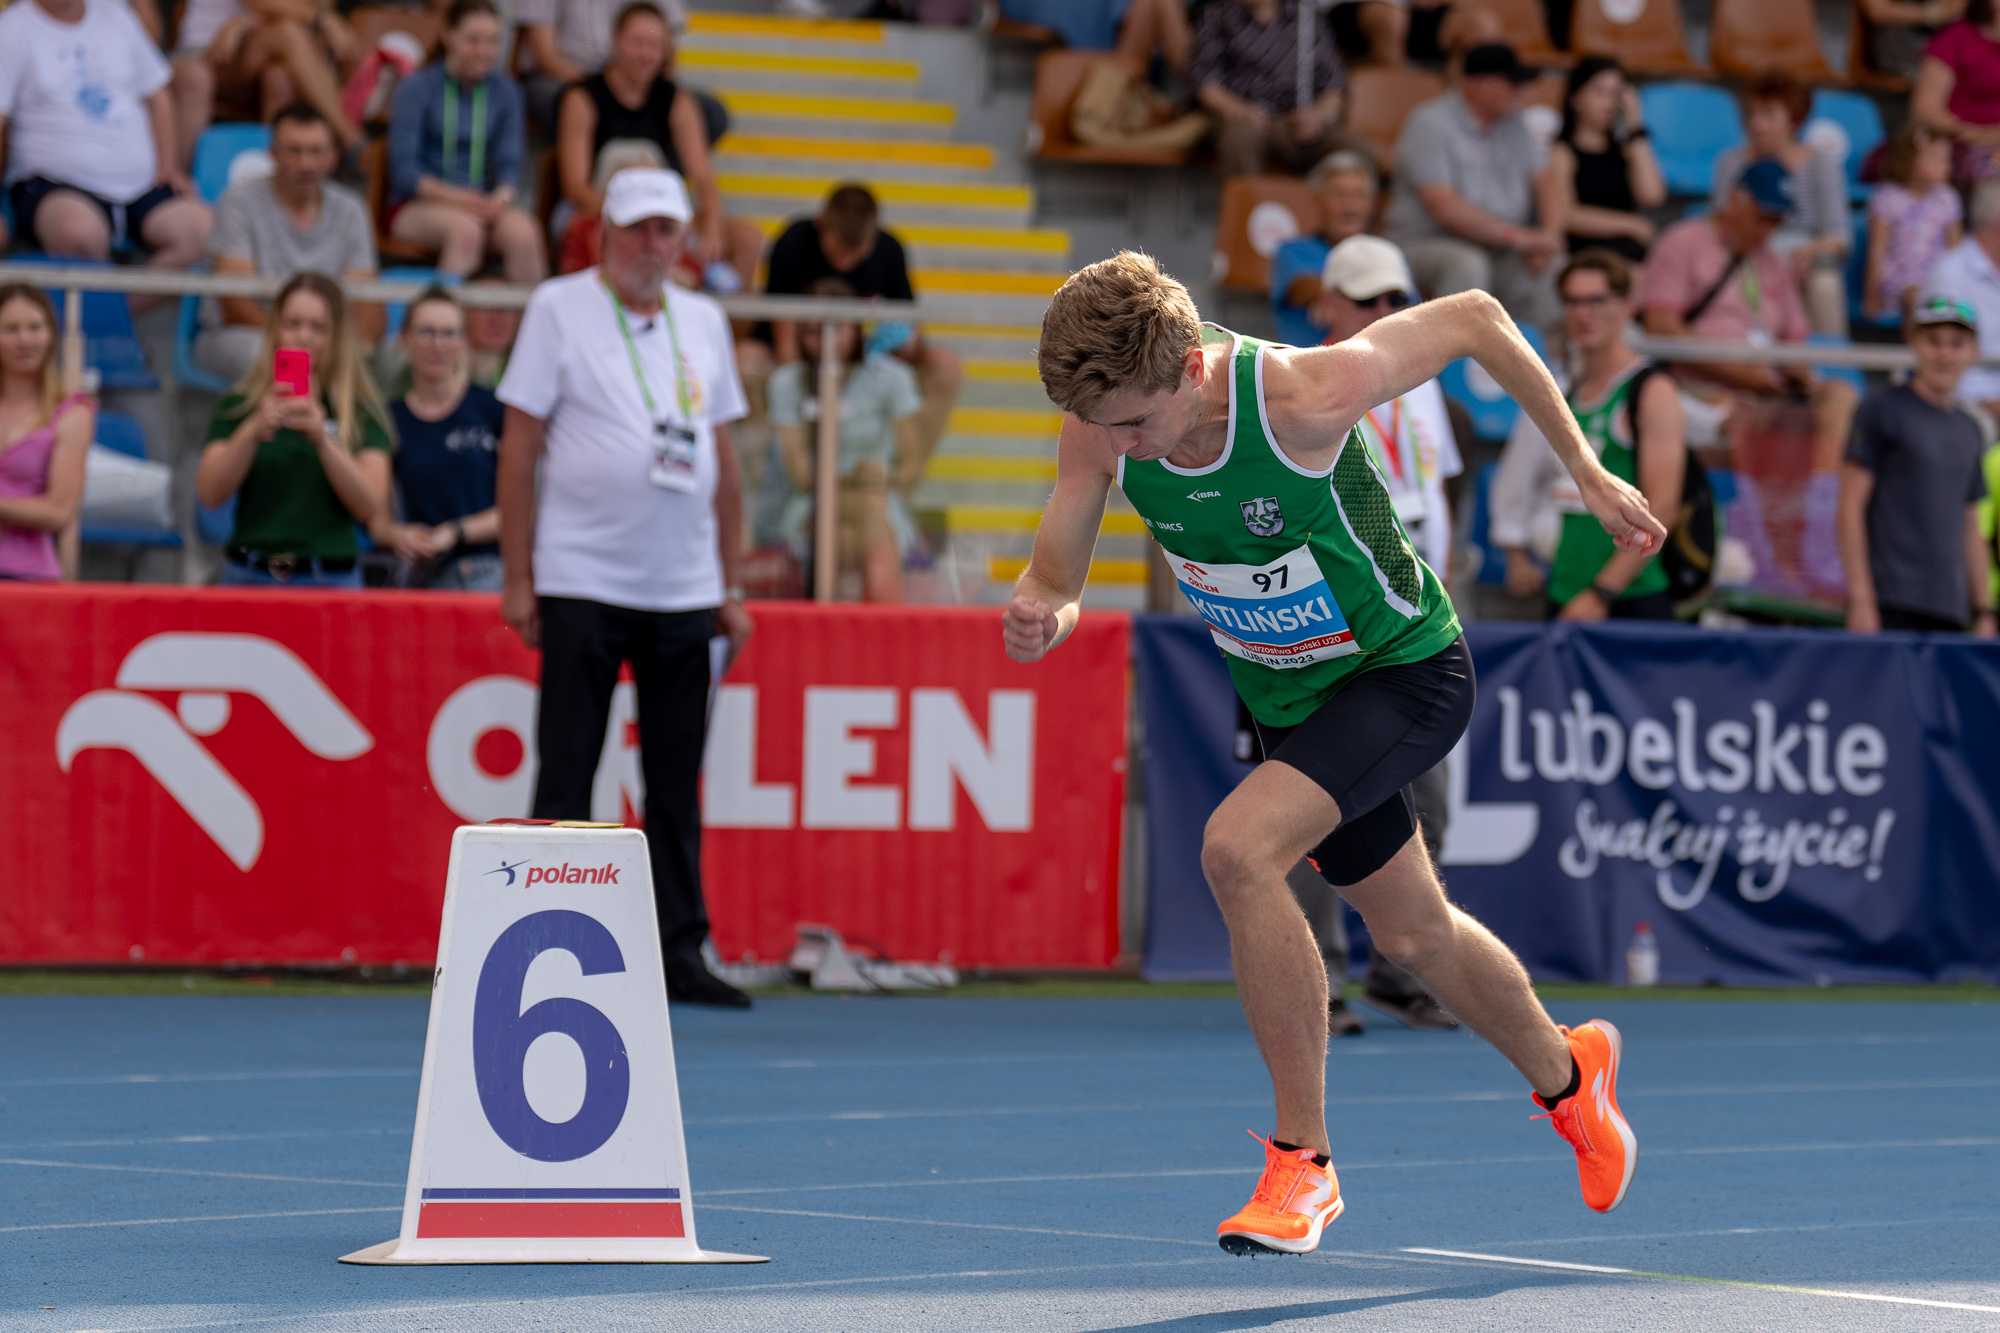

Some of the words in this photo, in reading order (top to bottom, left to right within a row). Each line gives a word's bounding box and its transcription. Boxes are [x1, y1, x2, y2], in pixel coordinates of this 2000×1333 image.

[1156, 520, 1184, 532] UMCS
[1188, 577, 1220, 594] ORLEN
[1252, 564, 1288, 593] 97
[1189, 594, 1333, 634] KITLIŃSKI
[1241, 649, 1281, 665] LUBLIN
[1282, 654, 1315, 665] 2023
[1293, 639, 1321, 653] Polski
[1322, 635, 1342, 646] U20
[1498, 685, 1888, 796] lubelskie
[1736, 806, 1896, 903] życie!
[525, 862, 621, 889] polanik
[473, 909, 630, 1163] 6
